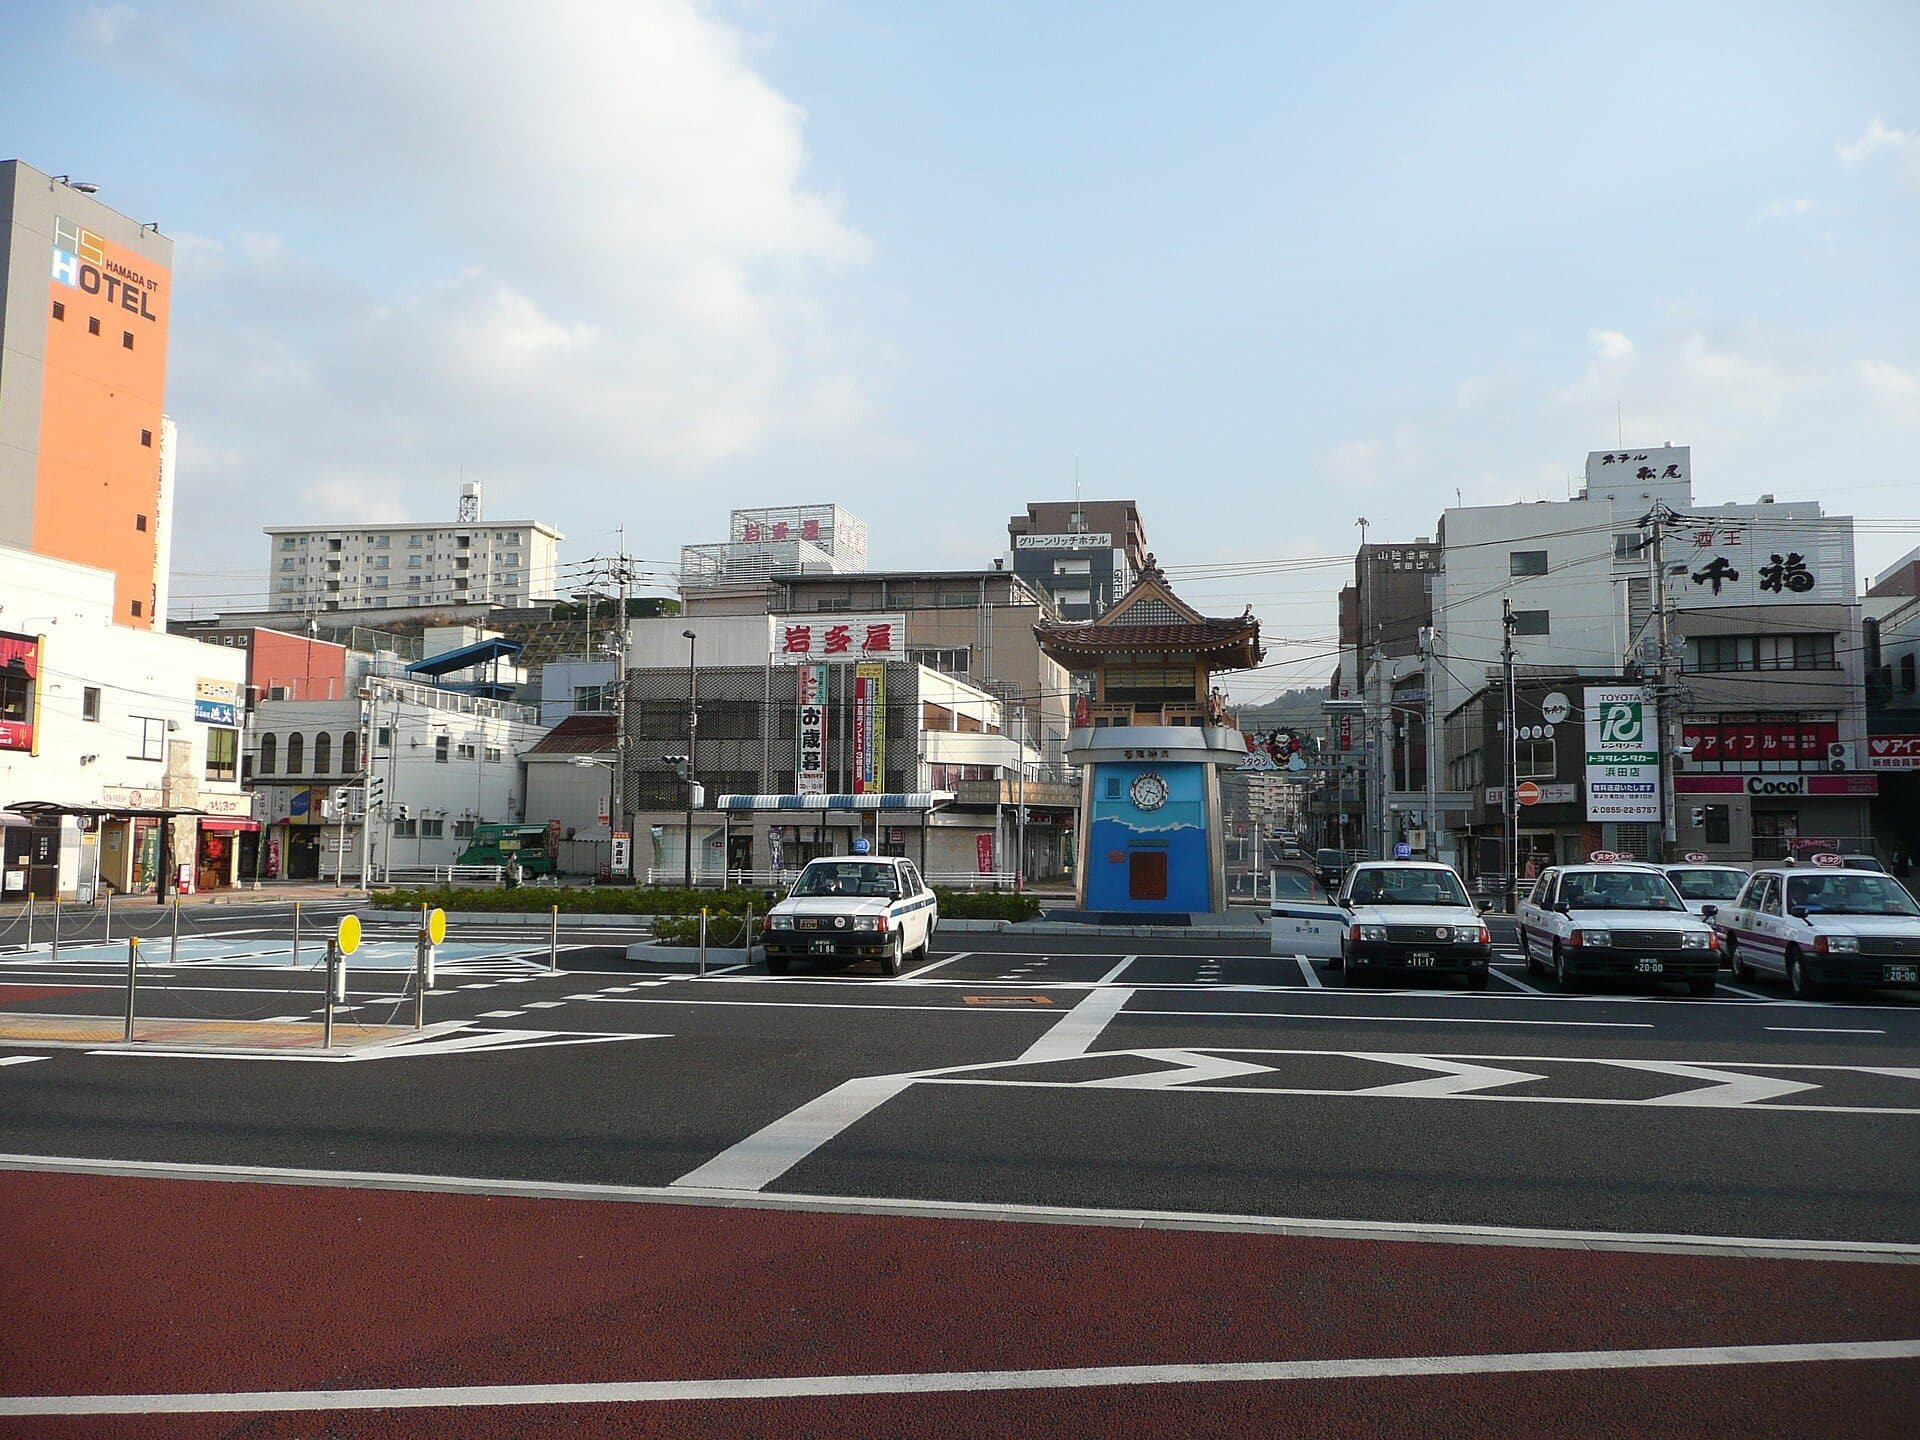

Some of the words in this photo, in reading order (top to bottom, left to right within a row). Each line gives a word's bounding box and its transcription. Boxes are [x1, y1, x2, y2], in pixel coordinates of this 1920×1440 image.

[105, 259, 145, 286] HAMADA
[146, 279, 159, 292] ST
[52, 248, 156, 322] HOTEL
[1602, 453, 1648, 465] ホテル
[1636, 464, 1682, 480] 松尾
[1018, 535, 1108, 547] グリーンリッチホテル
[1693, 531, 1742, 548] 酒王
[1691, 552, 1816, 596] 千福
[782, 623, 892, 654] 岩多屋
[802, 706, 821, 771] お歳暮
[1704, 735, 1777, 749] アイフル
[1605, 767, 1640, 777] 浜田店
[1747, 776, 1804, 794] Coco!
[1413, 957, 1435, 967] 11-17
[1639, 963, 1663, 972] 20-00
[1890, 971, 1916, 981] 20-00
